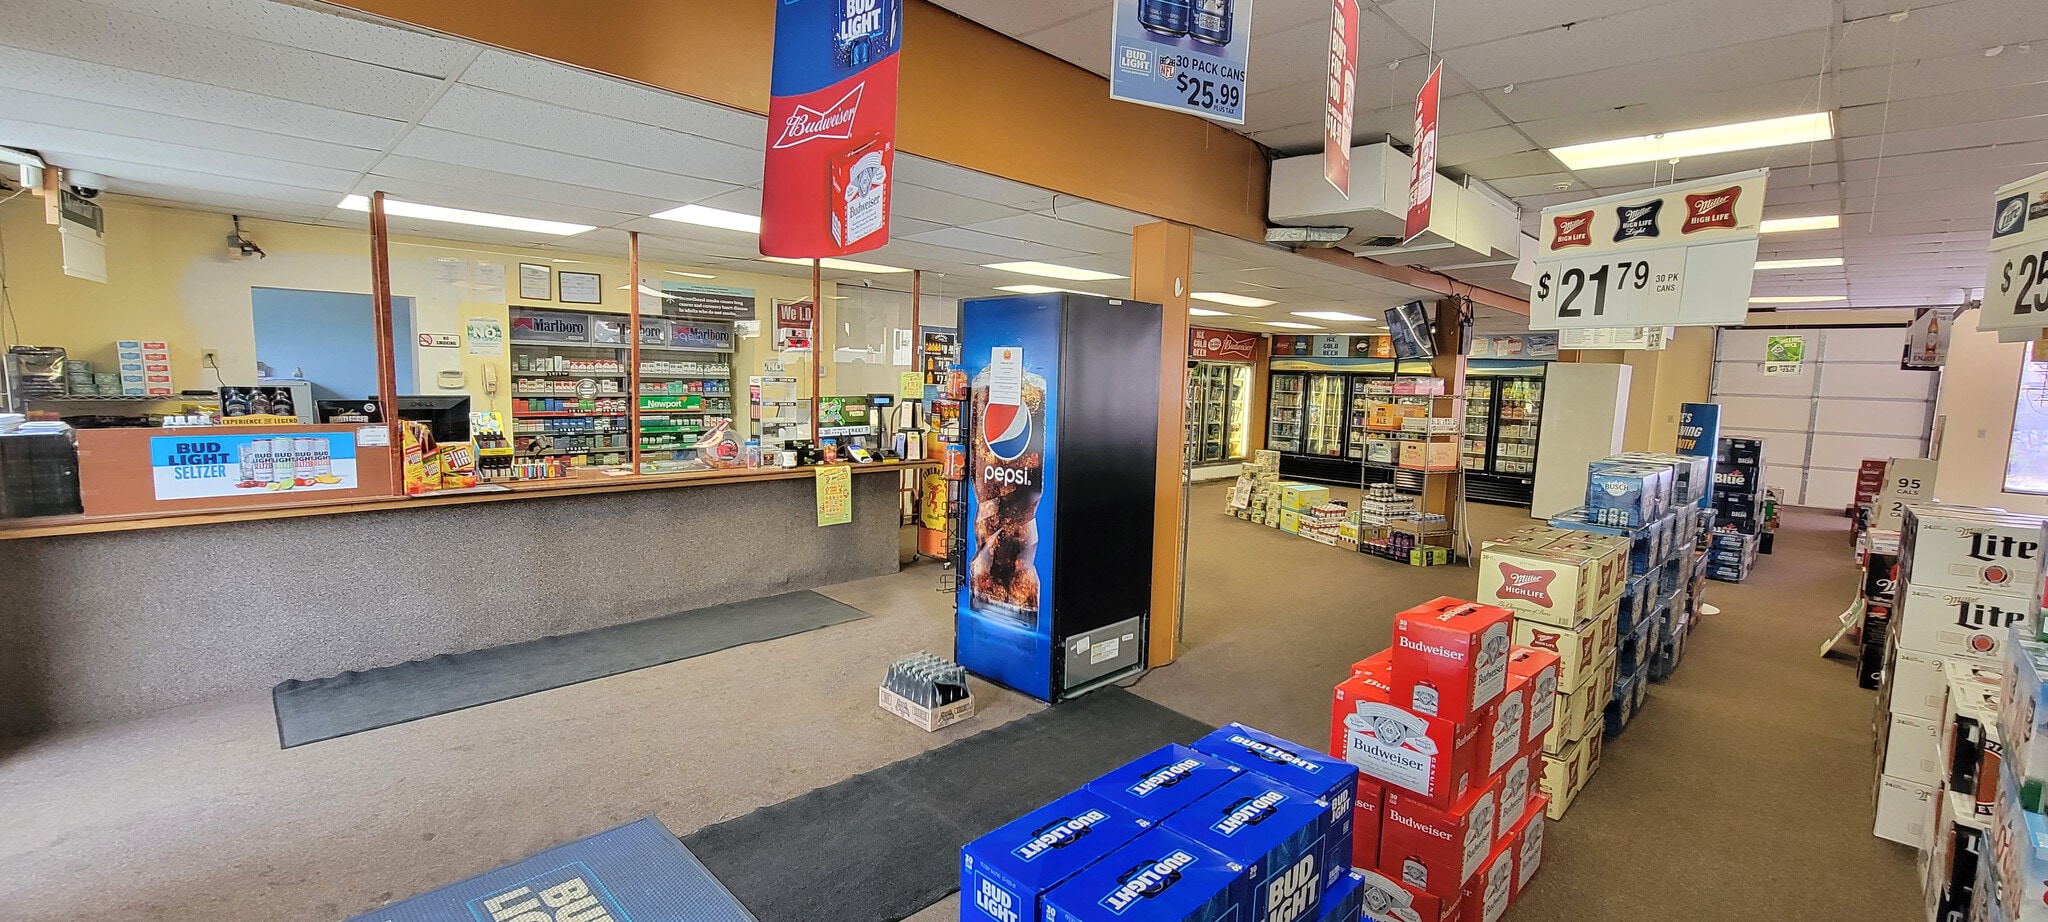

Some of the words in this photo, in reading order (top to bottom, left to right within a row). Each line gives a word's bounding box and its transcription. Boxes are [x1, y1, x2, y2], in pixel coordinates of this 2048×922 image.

[846, 0, 880, 14] BUD
[841, 10, 881, 40] LIGHT
[1125, 49, 1147, 60] BUD
[1121, 57, 1150, 70] LIGHT
[1160, 65, 1174, 77] NFL
[1176, 55, 1189, 69] 30
[1191, 58, 1219, 76] PACK
[1220, 66, 1245, 83] CANS
[1176, 72, 1239, 109] $25.99
[786, 106, 856, 137] Budweiser
[849, 195, 881, 219] Budweiser
[1694, 194, 1730, 215] Miller
[1625, 206, 1653, 222] Miller
[1690, 215, 1710, 225] HIGH
[1711, 213, 1729, 222] LIFE
[1560, 218, 1587, 234] Miller
[1622, 221, 1638, 229] HIGH
[1639, 219, 1653, 227] LIFE
[1625, 226, 1646, 237] Light
[1557, 234, 1572, 243] HIGH
[1573, 232, 1586, 241] LIFE
[1655, 274, 1666, 283] 30
[1667, 273, 1679, 282] PK
[1656, 284, 1676, 293] CANS
[780, 305, 797, 320] We
[533, 317, 584, 334] Marlboro
[690, 327, 730, 342] Marlboro
[1196, 330, 1206, 339] ICE
[1193, 339, 1207, 348] COLD
[1223, 338, 1253, 352] Budweiser
[1192, 348, 1207, 357] BEER
[647, 399, 682, 409] Newport
[176, 442, 222, 454] BUD
[168, 453, 230, 466] LIGHT
[174, 465, 227, 480] SELTZER
[984, 464, 1029, 486] pepsi
[1714, 474, 1745, 485] Blue
[1604, 483, 1629, 491] BUSCH
[1898, 478, 1921, 489] 95
[1955, 526, 1993, 539] Miller
[1967, 532, 2038, 562] Lite
[1510, 573, 1543, 587] Miller
[1505, 586, 1526, 596] HIGH
[1526, 589, 1544, 599] LIFE
[1943, 594, 1980, 607] Miller
[1955, 601, 2025, 630] Lite
[1399, 635, 1464, 661] Budweiser
[1478, 662, 1505, 686] Budweiser
[1494, 728, 1519, 753] Budweiser
[1230, 735, 1264, 756] BUD
[1264, 745, 1319, 773] LIGHT
[1354, 738, 1424, 772] Budweiser
[1171, 758, 1203, 778] BUD
[1135, 767, 1178, 796] LIGHT
[1428, 757, 1437, 798] GENUINE
[1252, 790, 1285, 810] BUD
[1332, 789, 1348, 811] BUD
[1071, 809, 1105, 831] BUD
[1218, 802, 1258, 834] LIGHT
[1389, 808, 1453, 841] Budweiser
[1023, 822, 1073, 860] LIGHT
[1154, 850, 1194, 876] BUD
[1107, 865, 1160, 911] LIGHT
[1268, 854, 1314, 913] BUD
[982, 878, 1012, 909] BUD
[976, 889, 1018, 922] LIGHT
[1045, 905, 1056, 916] 30
